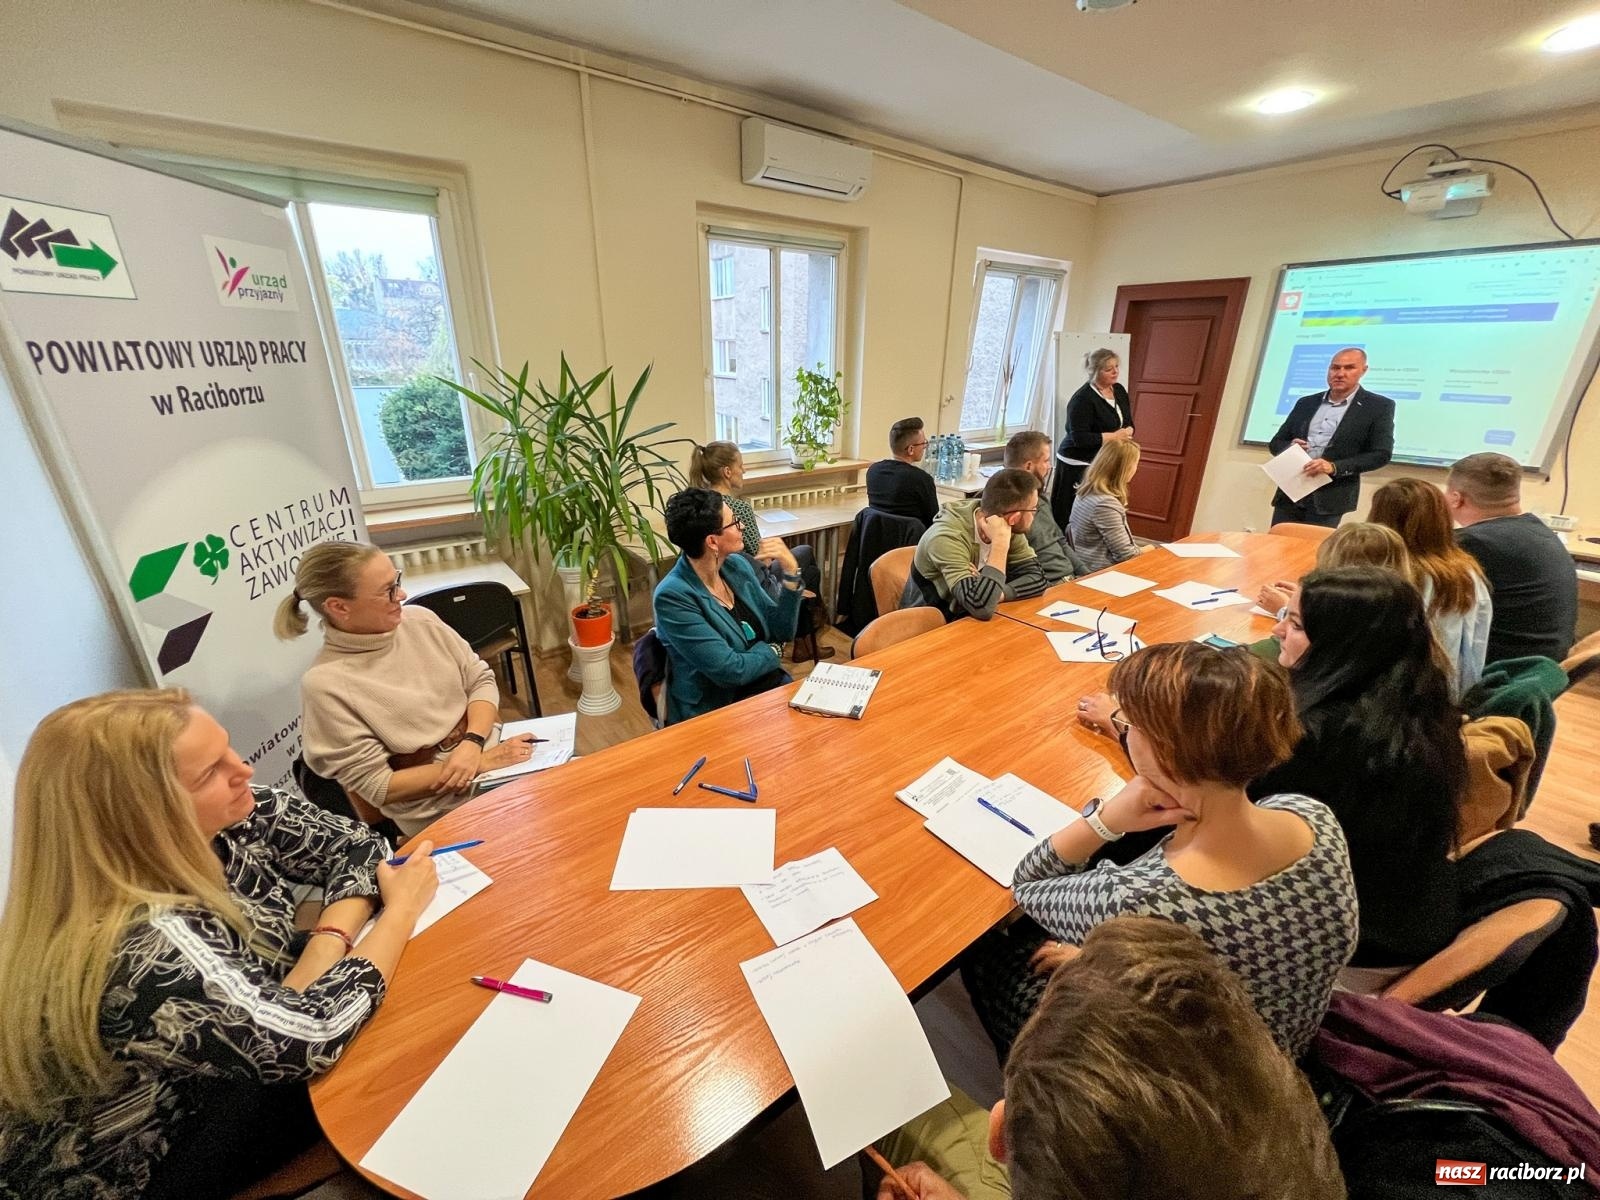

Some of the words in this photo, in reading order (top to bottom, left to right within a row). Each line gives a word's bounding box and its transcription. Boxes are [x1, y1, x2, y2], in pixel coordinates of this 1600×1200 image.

[238, 287, 284, 303] przyjazny
[26, 340, 196, 375] POWIATOWY
[198, 340, 258, 373] URZĄD
[259, 340, 307, 365] PRACY
[151, 394, 174, 416] w
[176, 381, 265, 413] Raciborzu
[230, 487, 350, 548] CENTRUM
[240, 508, 355, 576] AKTYWIZACJI
